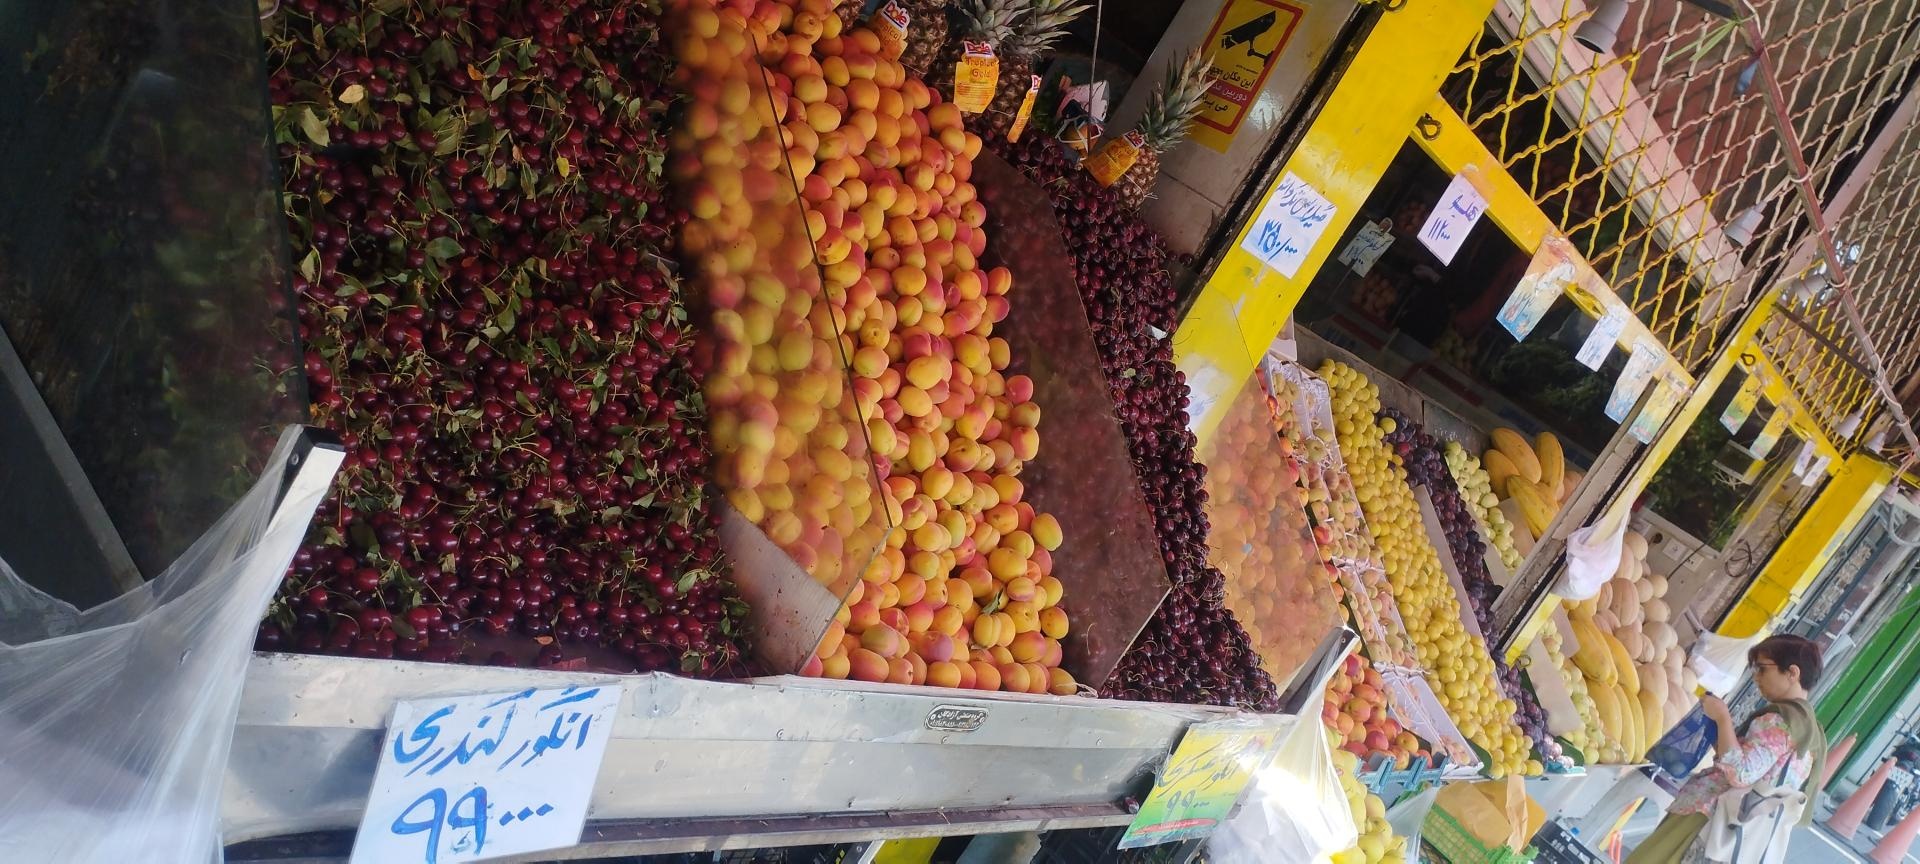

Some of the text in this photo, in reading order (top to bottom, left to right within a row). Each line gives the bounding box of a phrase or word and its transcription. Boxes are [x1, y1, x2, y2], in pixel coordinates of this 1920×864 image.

[884, 2, 907, 24] Dole
[966, 42, 992, 53] Dole
[1222, 71, 1241, 81] مکان
[1240, 79, 1256, 89] این
[1222, 89, 1247, 101] دوربین
[1214, 103, 1229, 112] می
[496, 685, 601, 772] انگور
[391, 786, 554, 864] ۹۹۰۰۰
